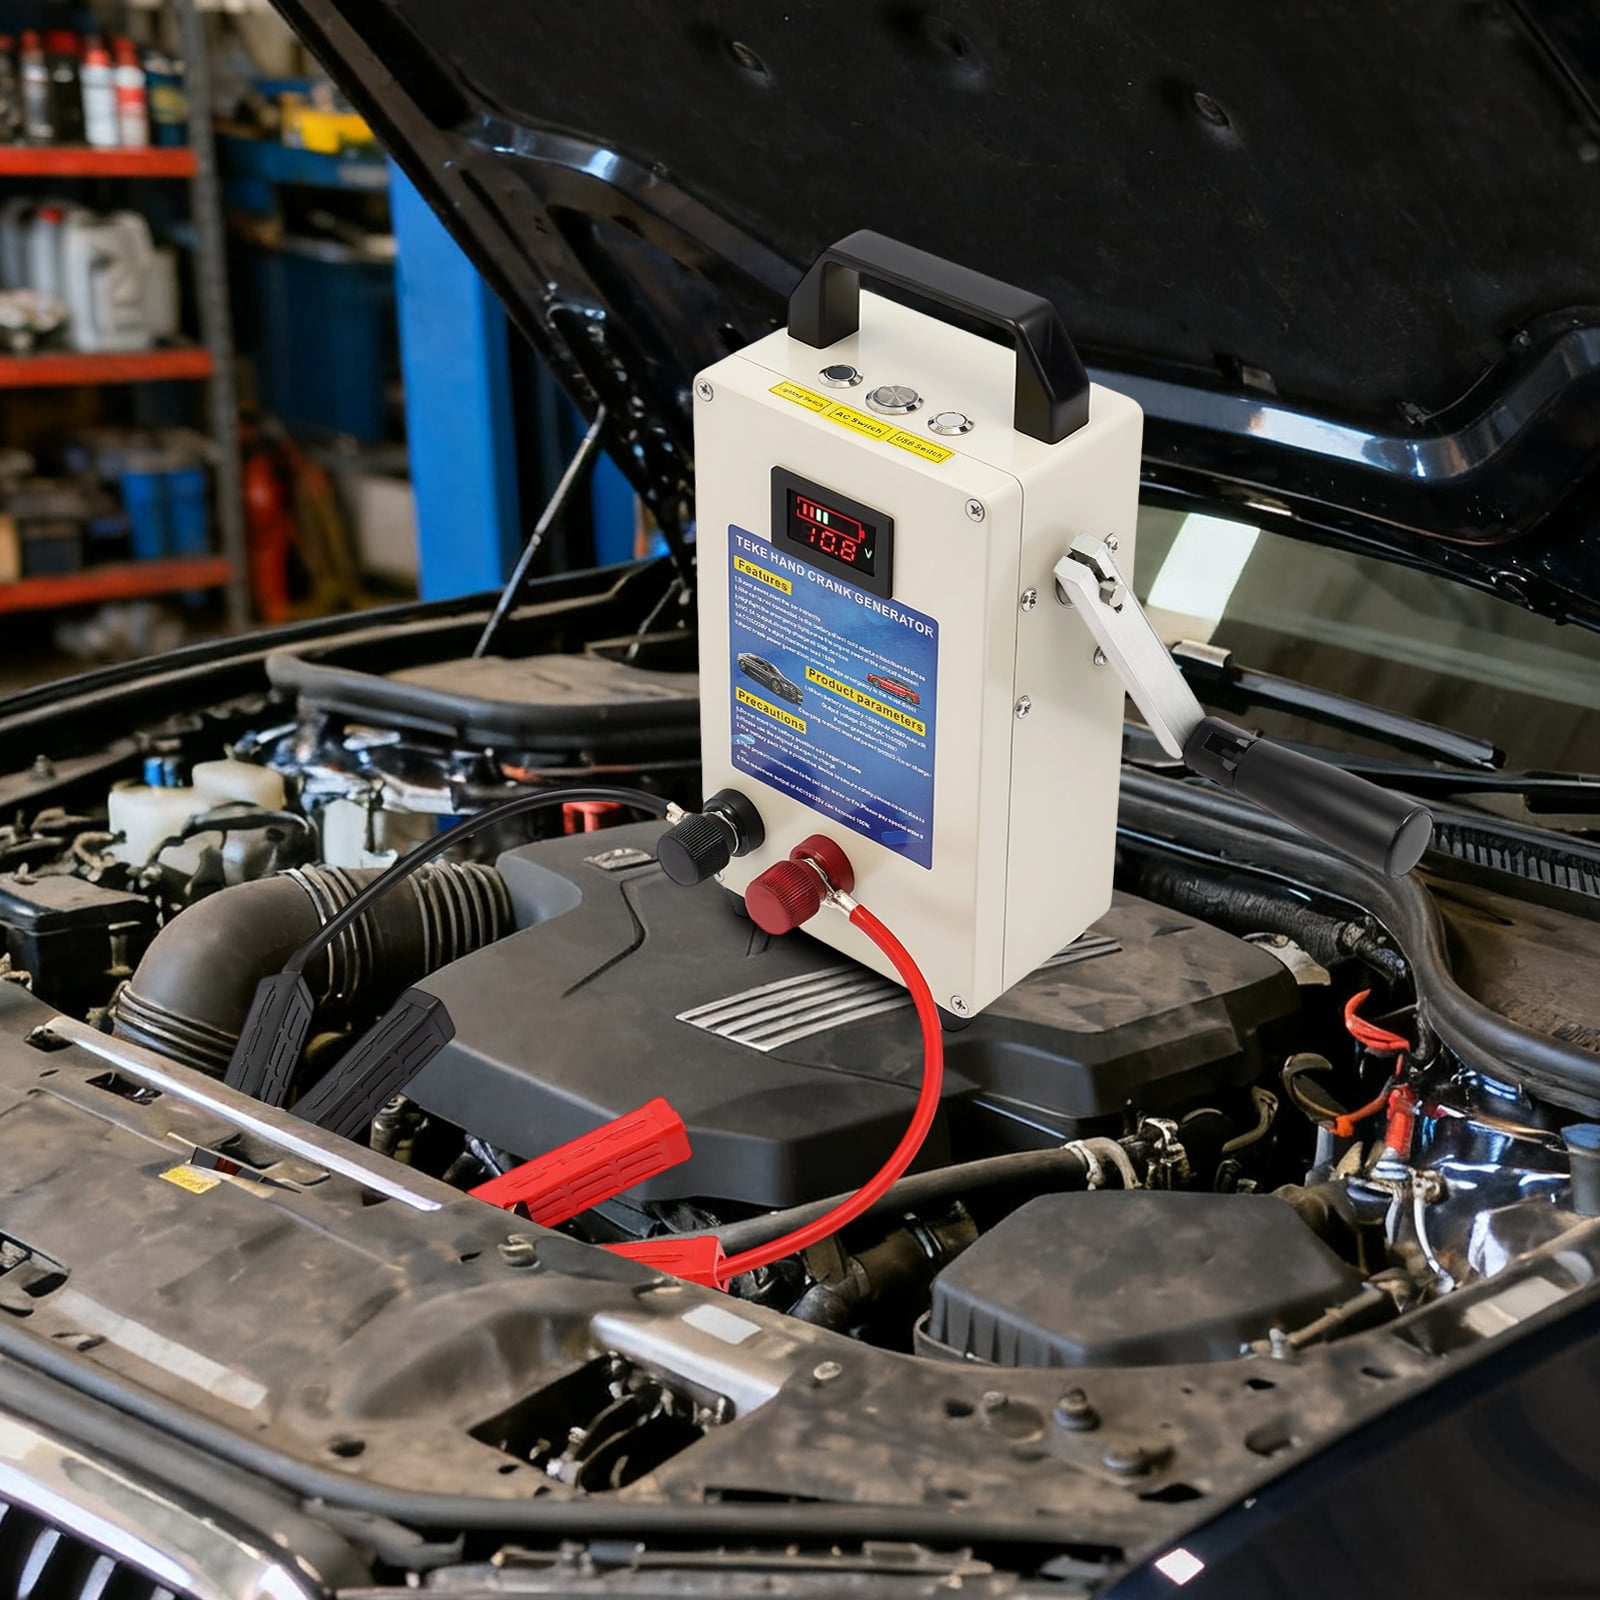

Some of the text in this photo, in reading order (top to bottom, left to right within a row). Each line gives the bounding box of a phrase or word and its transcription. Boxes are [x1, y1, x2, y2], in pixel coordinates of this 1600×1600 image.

[835, 411, 882, 435] AC Switch
[896, 435, 944, 459] USB Switch
[810, 527, 857, 562] 10.8
[736, 535, 767, 560] TEKE
[770, 551, 803, 577] HAND
[807, 569, 852, 601] CRANK
[855, 591, 934, 640] GENERATOR
[738, 558, 787, 591] Features
[738, 689, 804, 732] Precautions
[809, 667, 854, 699] Product
[857, 692, 923, 734] parameters
